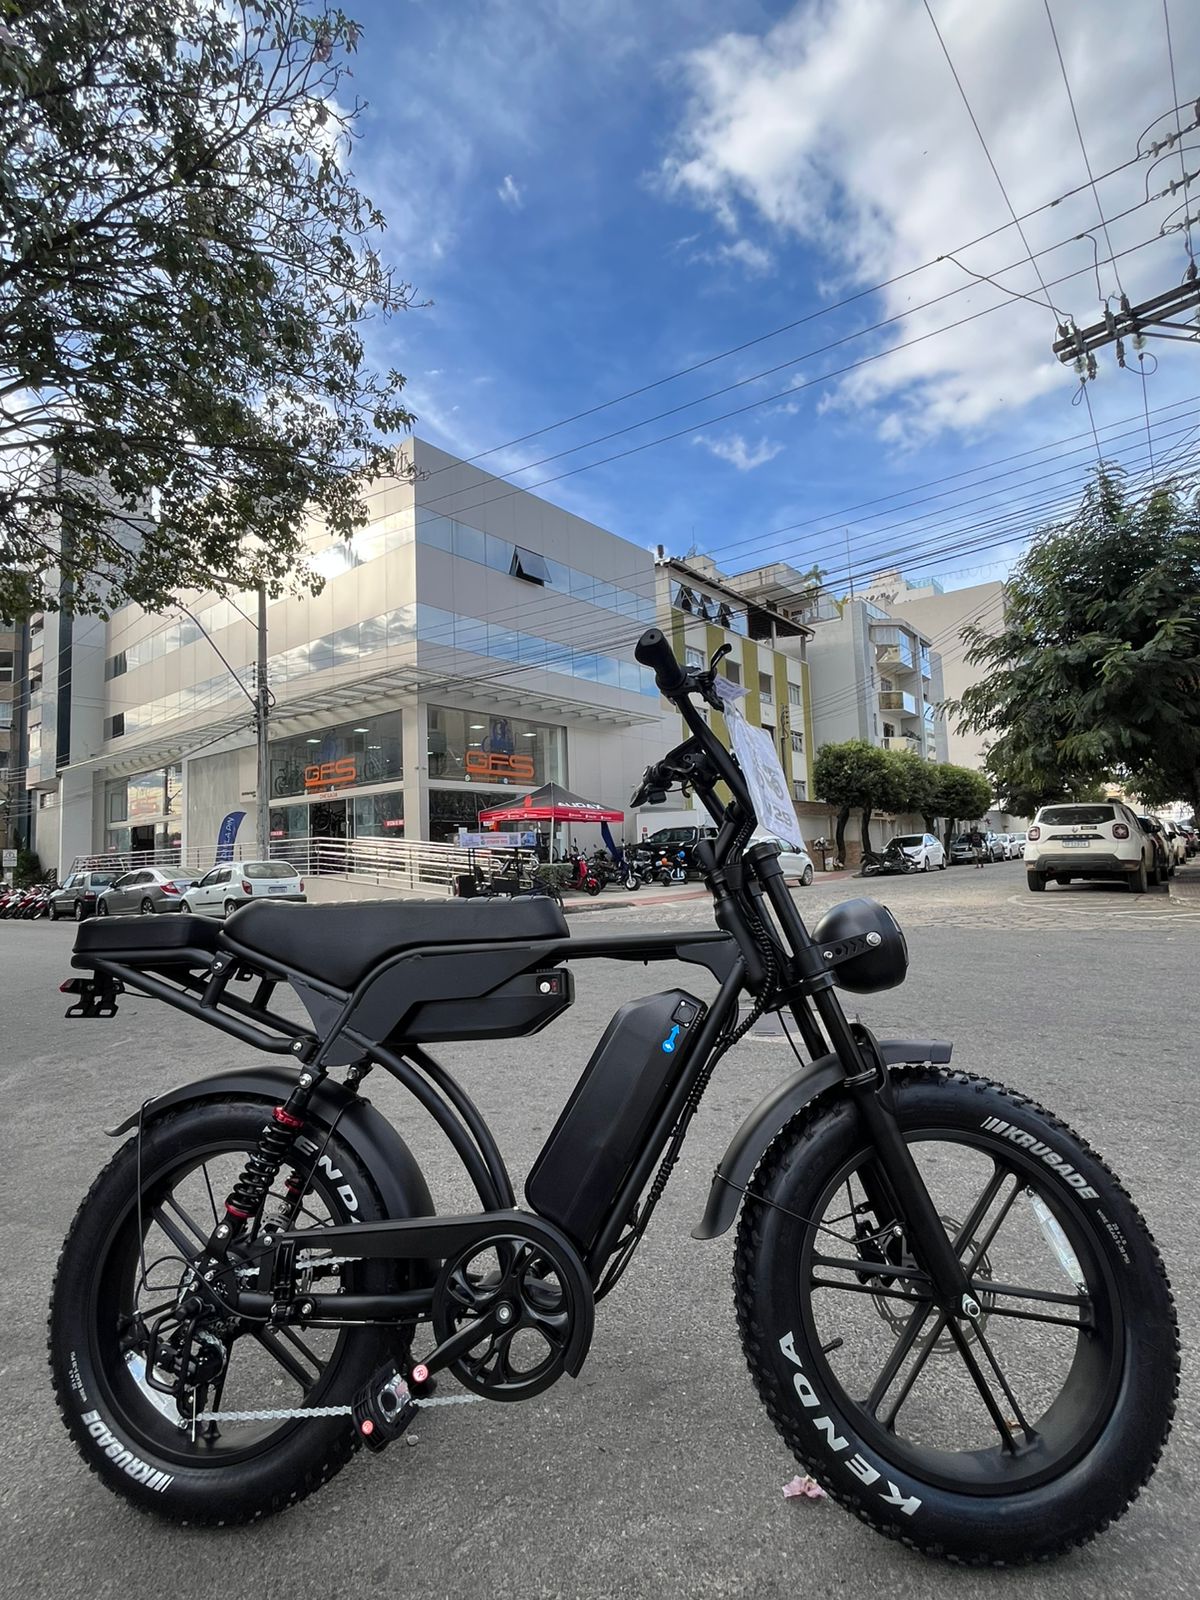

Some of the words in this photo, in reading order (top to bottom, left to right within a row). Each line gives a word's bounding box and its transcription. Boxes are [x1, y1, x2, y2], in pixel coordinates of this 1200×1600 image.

[1000, 1125, 1100, 1200] KRUSADE
[80, 1409, 158, 1484] KRUSADE
[778, 1330, 923, 1517] KENDA
